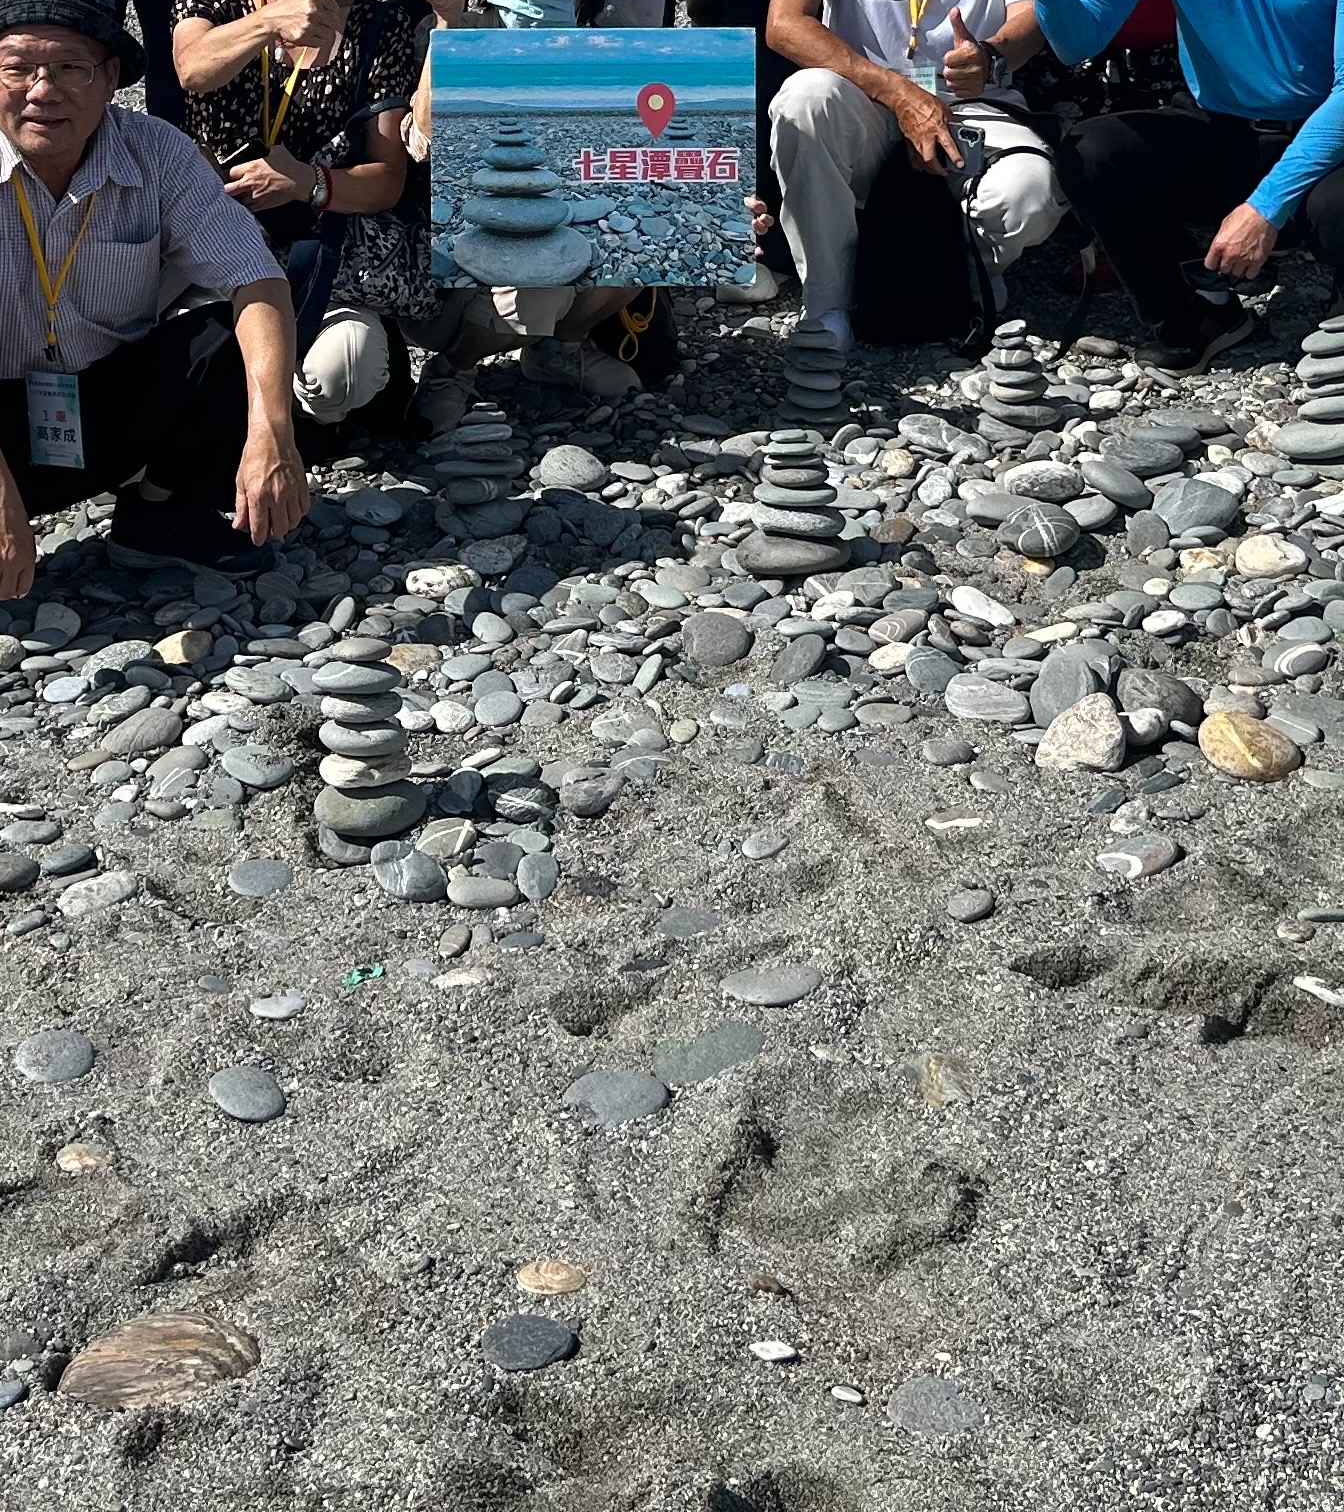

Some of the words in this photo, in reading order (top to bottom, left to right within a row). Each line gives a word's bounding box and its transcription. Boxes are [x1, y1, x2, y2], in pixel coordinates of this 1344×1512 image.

[573, 148, 740, 182] 七星潭疊石
